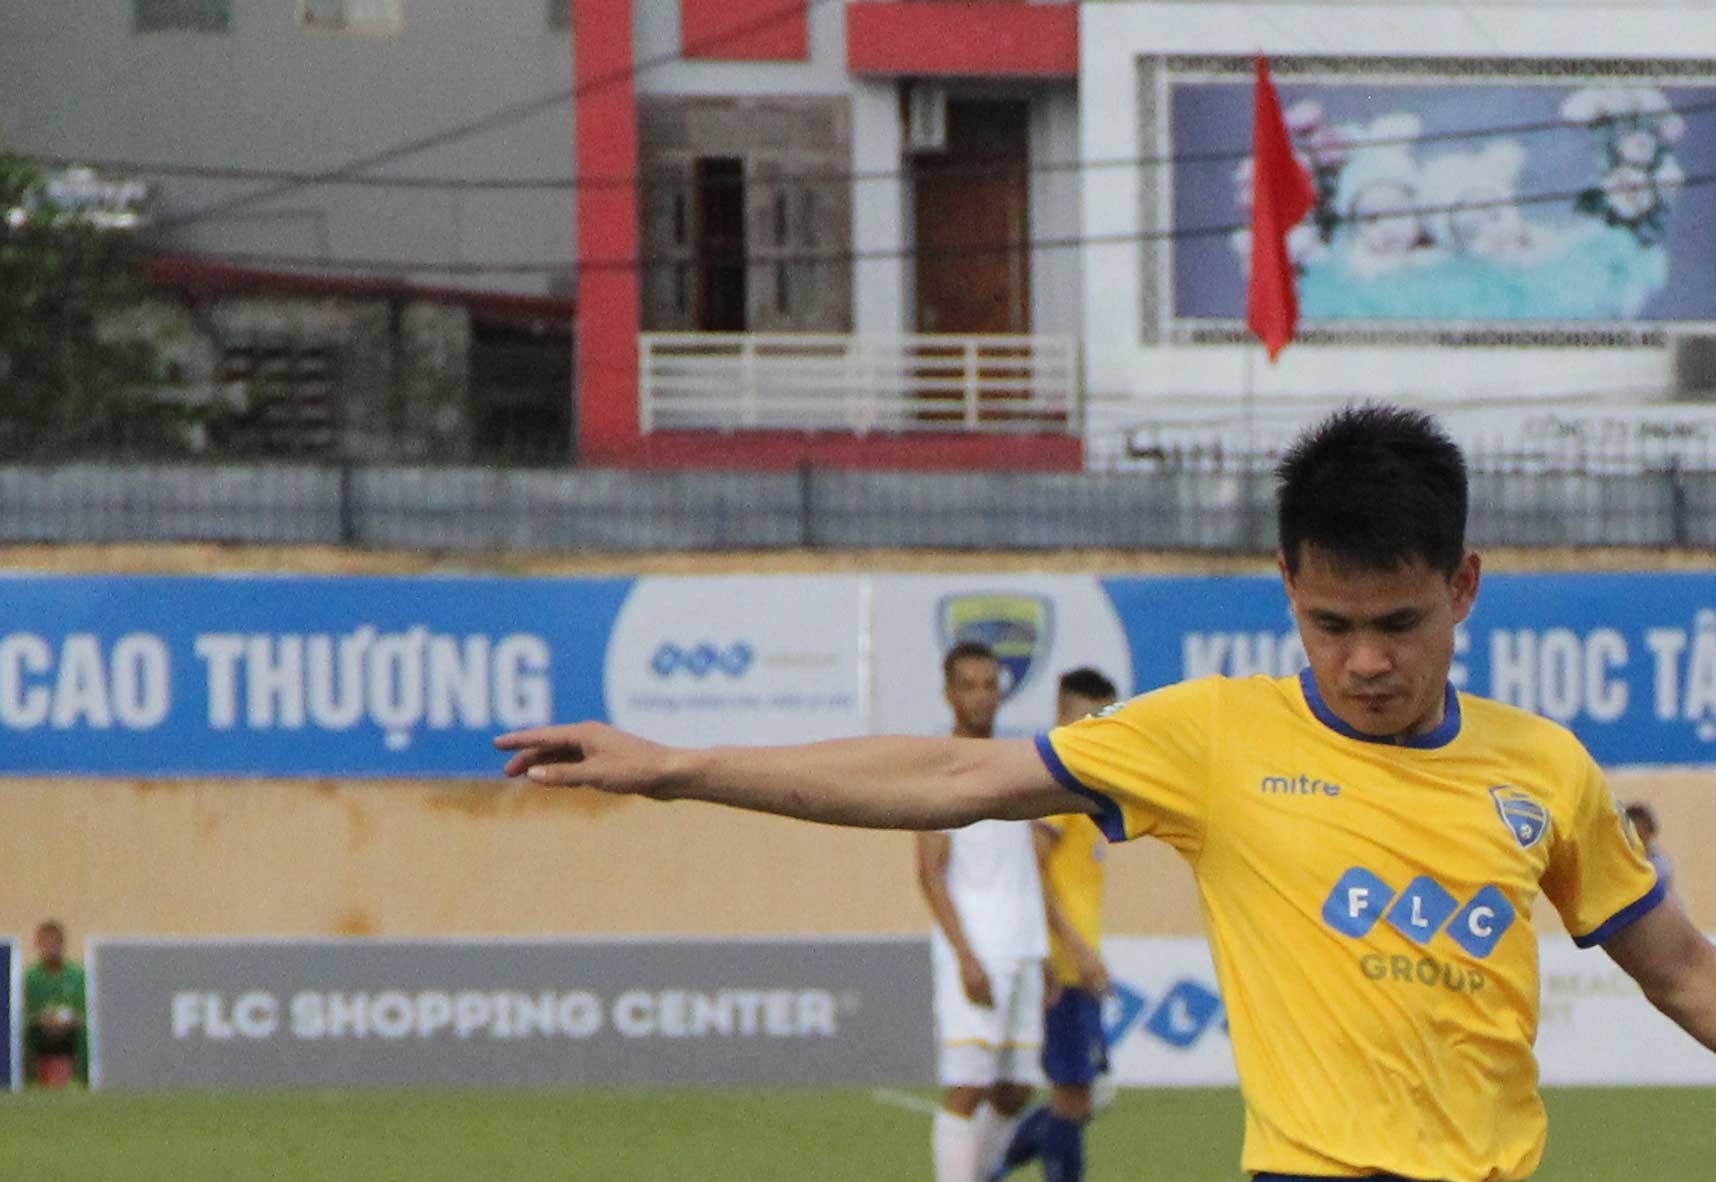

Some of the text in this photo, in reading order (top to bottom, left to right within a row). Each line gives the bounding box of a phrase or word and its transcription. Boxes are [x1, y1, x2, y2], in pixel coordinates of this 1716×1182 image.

[0, 624, 556, 751] CAO THƯỢNG
[1261, 774, 1341, 797] mitre
[1348, 887, 1493, 938] FLC
[1360, 953, 1487, 993] GROUP
[170, 988, 838, 1039] FLC SHOPPING CENTER
